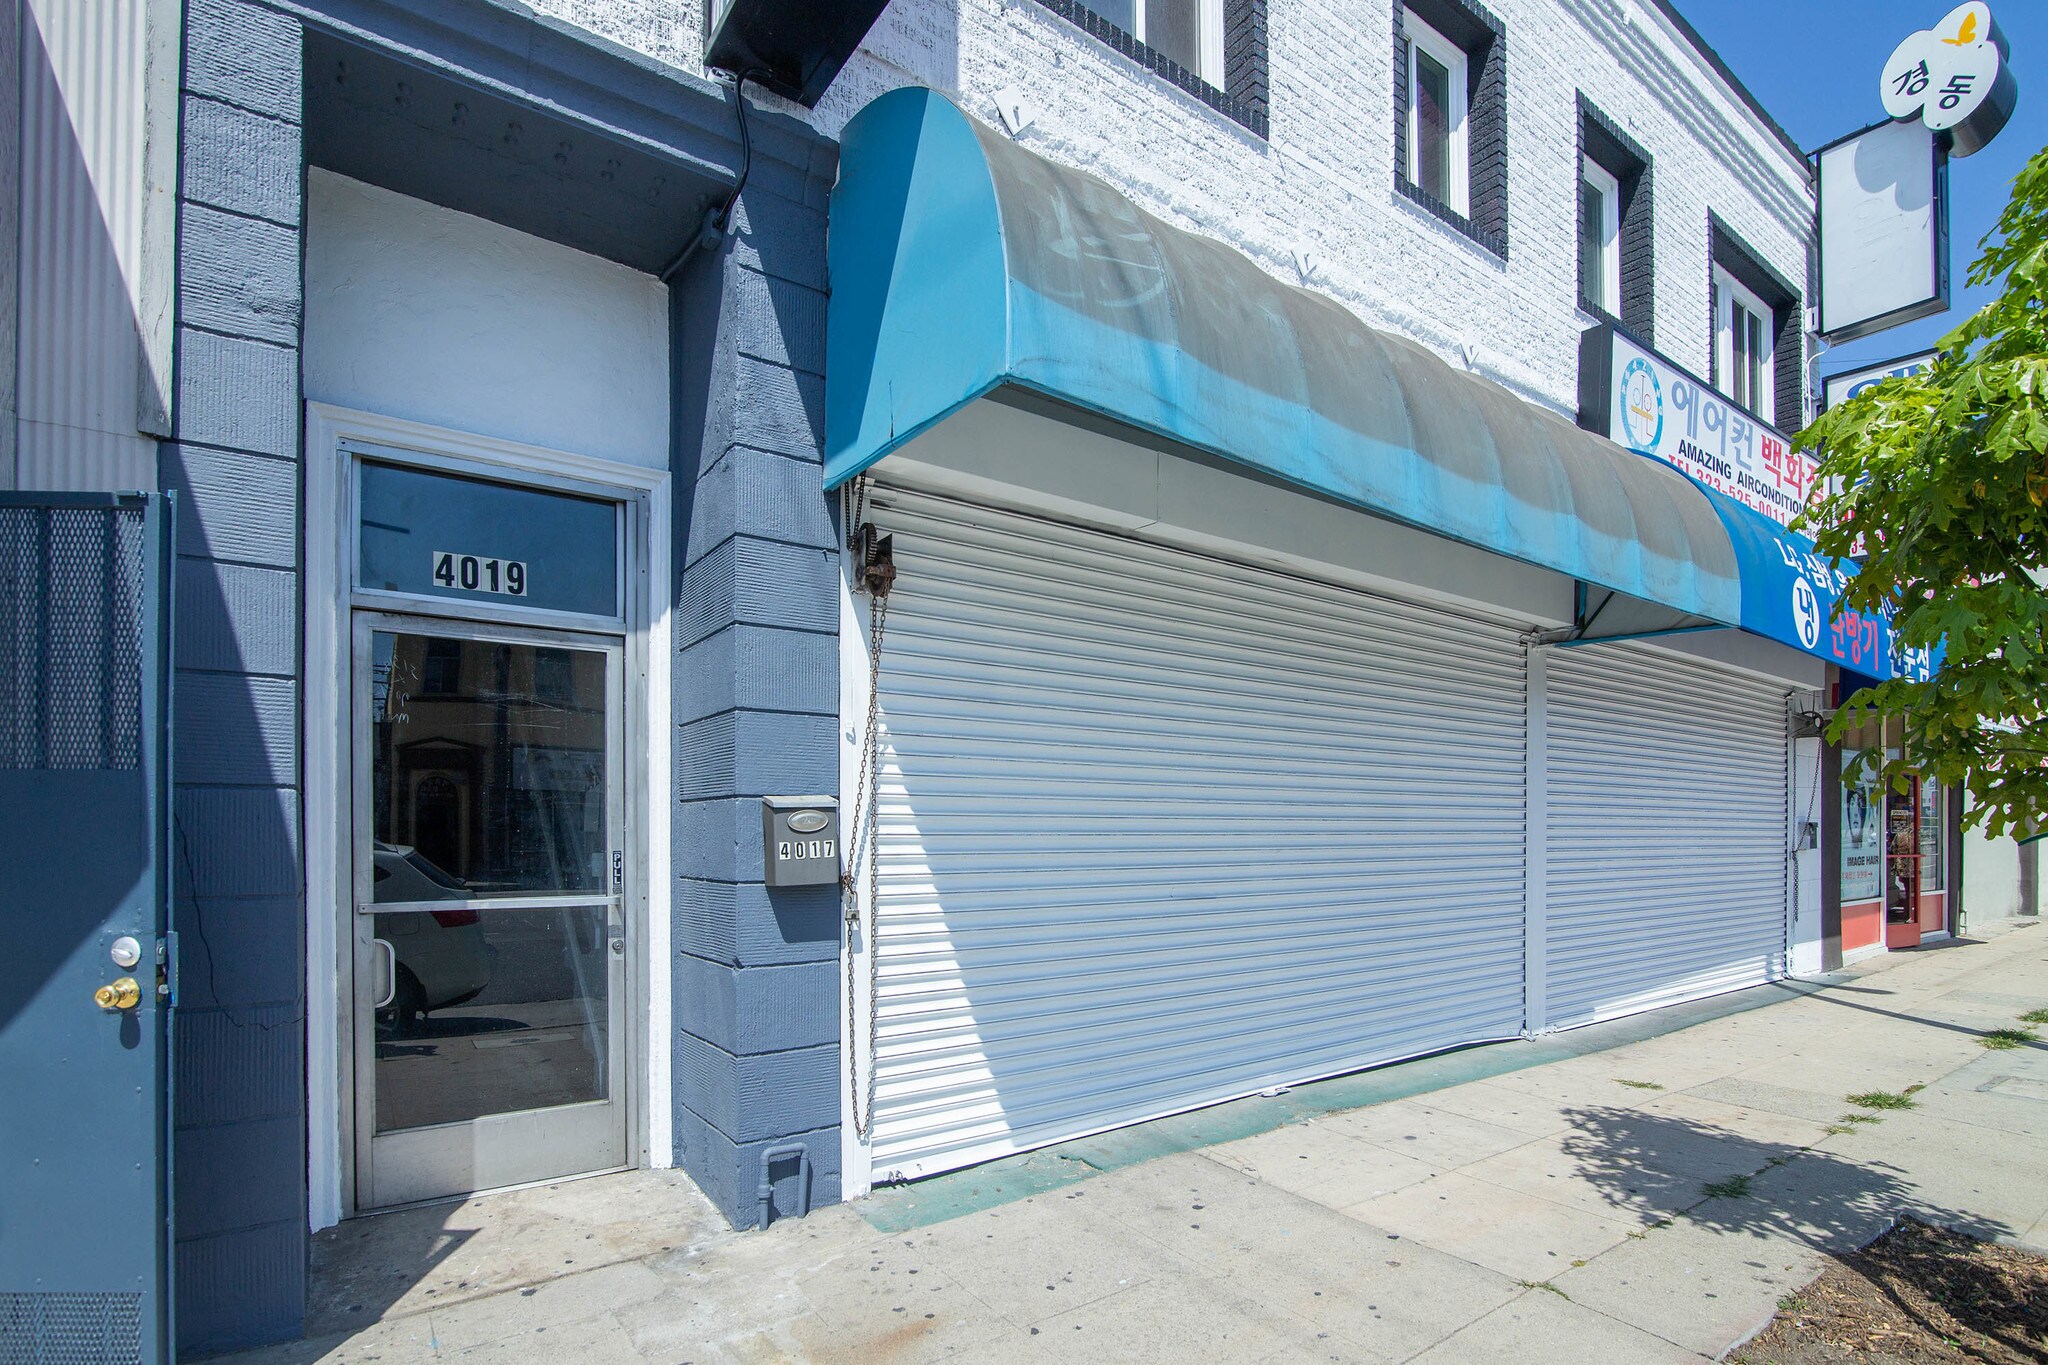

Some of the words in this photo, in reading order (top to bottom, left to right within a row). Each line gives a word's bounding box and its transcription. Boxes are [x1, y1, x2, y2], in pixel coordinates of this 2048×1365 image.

[1891, 58, 1977, 110] 경동
[1671, 380, 1754, 471] 에어컨
[1678, 439, 1732, 480] AMAZING
[435, 553, 525, 595] 4019
[1796, 586, 1815, 646] 냉
[613, 853, 621, 884] PULL
[780, 841, 833, 859] 4017
